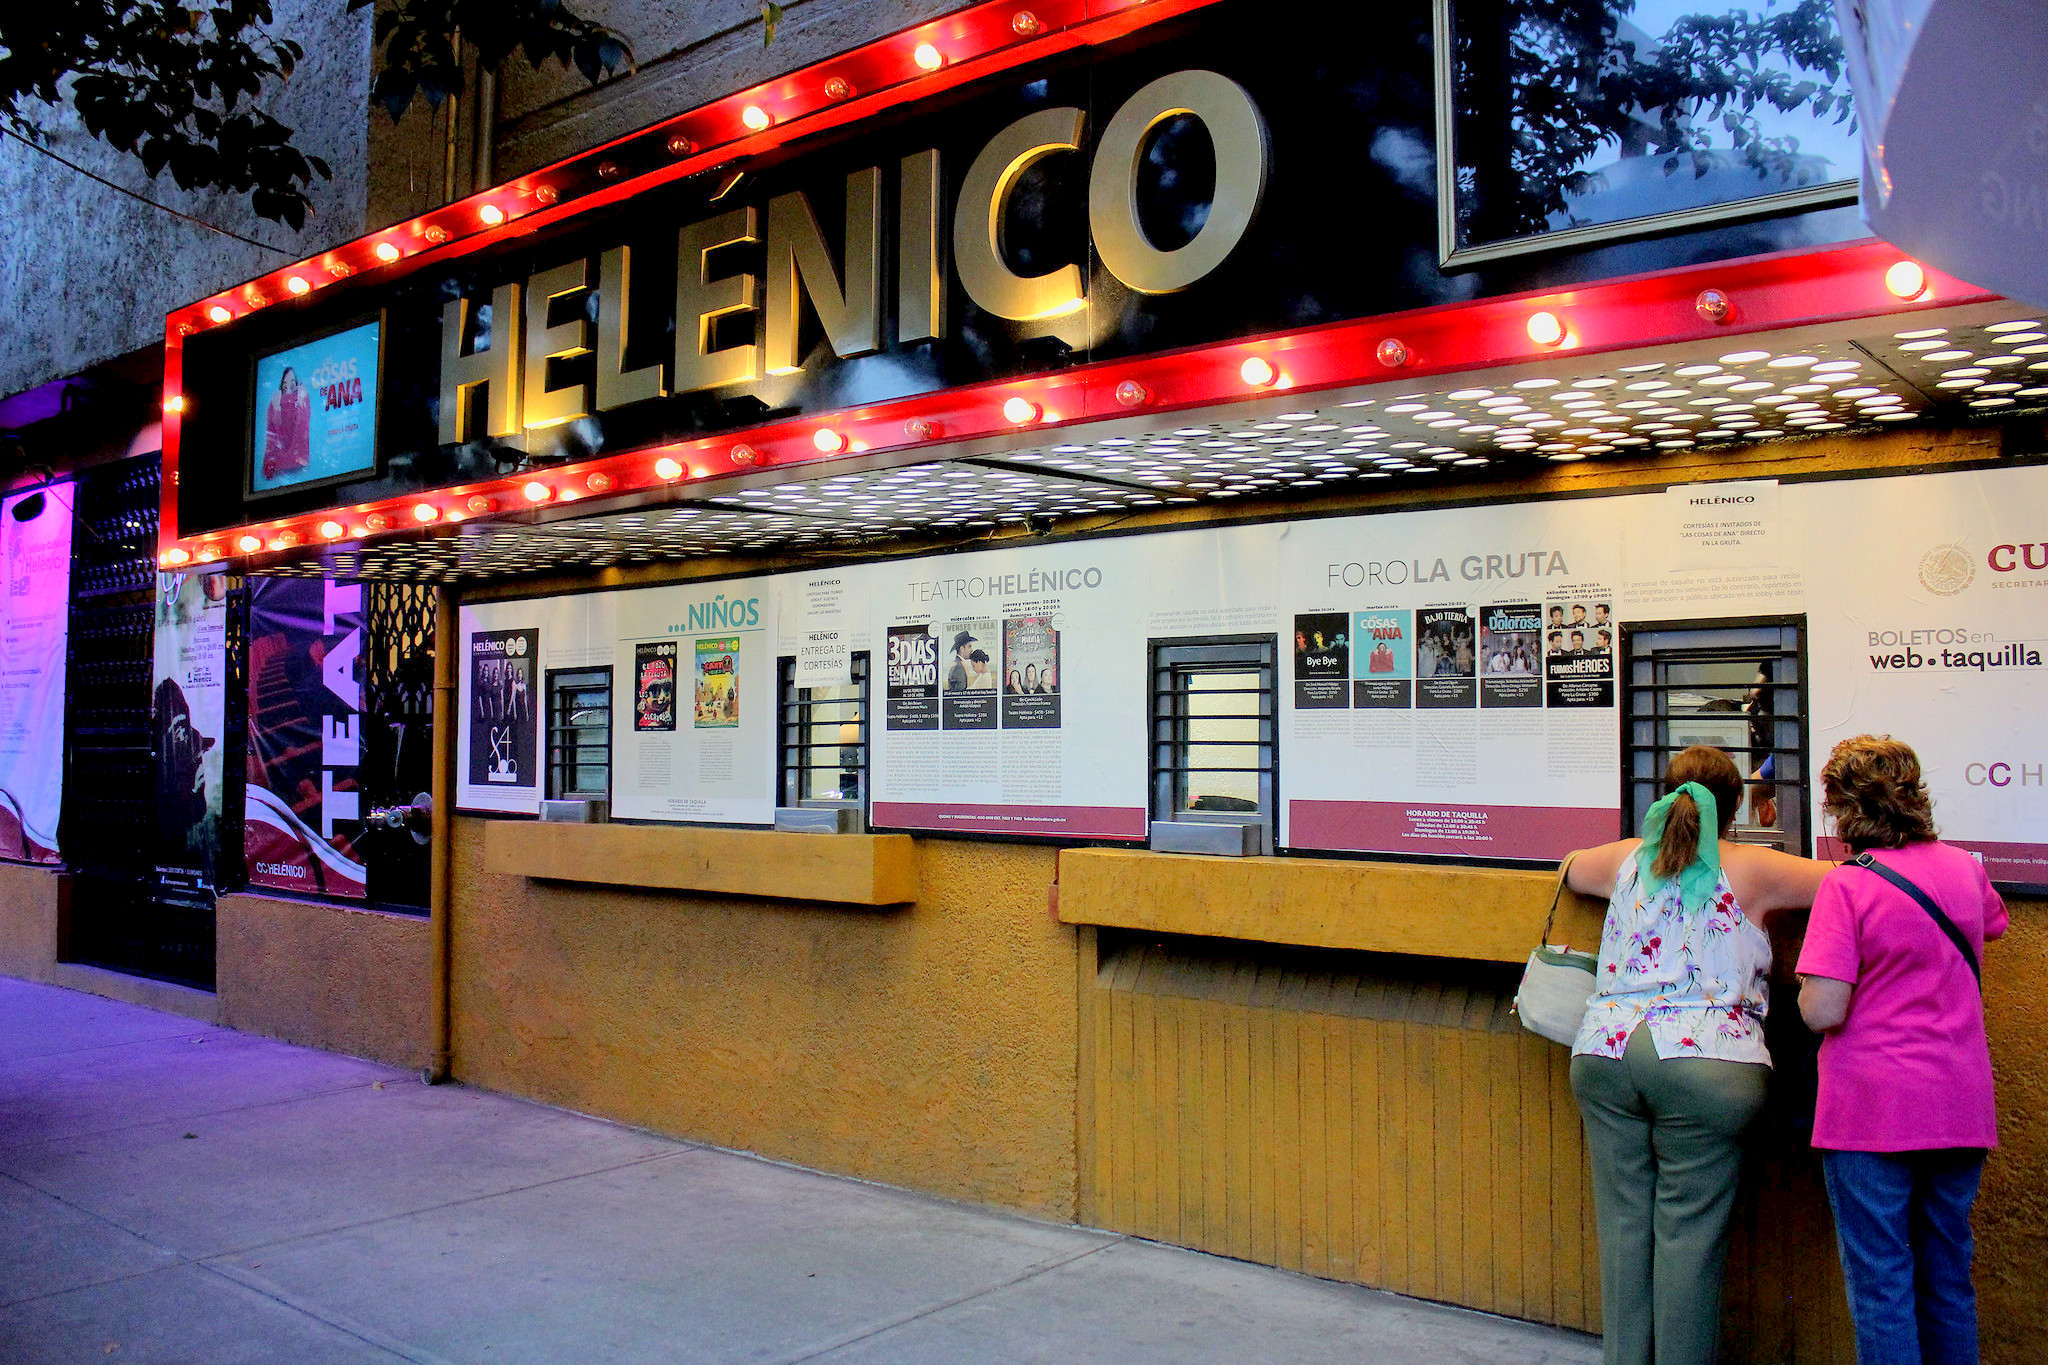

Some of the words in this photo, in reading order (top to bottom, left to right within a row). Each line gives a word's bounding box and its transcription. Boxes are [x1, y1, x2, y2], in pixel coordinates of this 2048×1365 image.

[437, 69, 1273, 444] HELÉNICO
[311, 357, 357, 389] COSAS
[324, 377, 363, 412] ANA
[1689, 495, 1755, 506] HELÉNICO
[1740, 529, 1766, 537] DIRECTO
[1327, 559, 1409, 588] FORO
[1413, 558, 1451, 584] LA
[1460, 550, 1570, 580] GRUTA
[808, 579, 842, 588] HELÉNICO
[1360, 618, 1398, 629] COSAS
[1424, 611, 1444, 625] BAJO
[1444, 611, 1468, 625] TIERRA
[1489, 616, 1542, 631] Dolorosa
[946, 623, 972, 632] WENSES
[979, 622, 995, 630] LALA
[1372, 627, 1403, 641] ANA
[808, 631, 839, 641] HELÉNICO
[1868, 628, 1968, 647] BOLETOS
[1970, 632, 1995, 644] en
[473, 638, 505, 652] HELÉNICO
[801, 646, 835, 656] ENTREGA
[836, 644, 846, 654] DE
[888, 636, 900, 666] 3
[900, 633, 936, 665] DÍAS
[803, 658, 843, 671] CORTESÍAS
[1306, 656, 1322, 668] Bye
[1322, 655, 1338, 667] Bye
[1572, 658, 1610, 674] HÉROES
[900, 664, 937, 686] MAYO
[1965, 762, 2012, 787] CC
[2021, 763, 2043, 787] H
[1406, 809, 1440, 817] HORARIO
[1451, 811, 1489, 820] TAQUILLA
[1990, 856, 2012, 864] requiere
